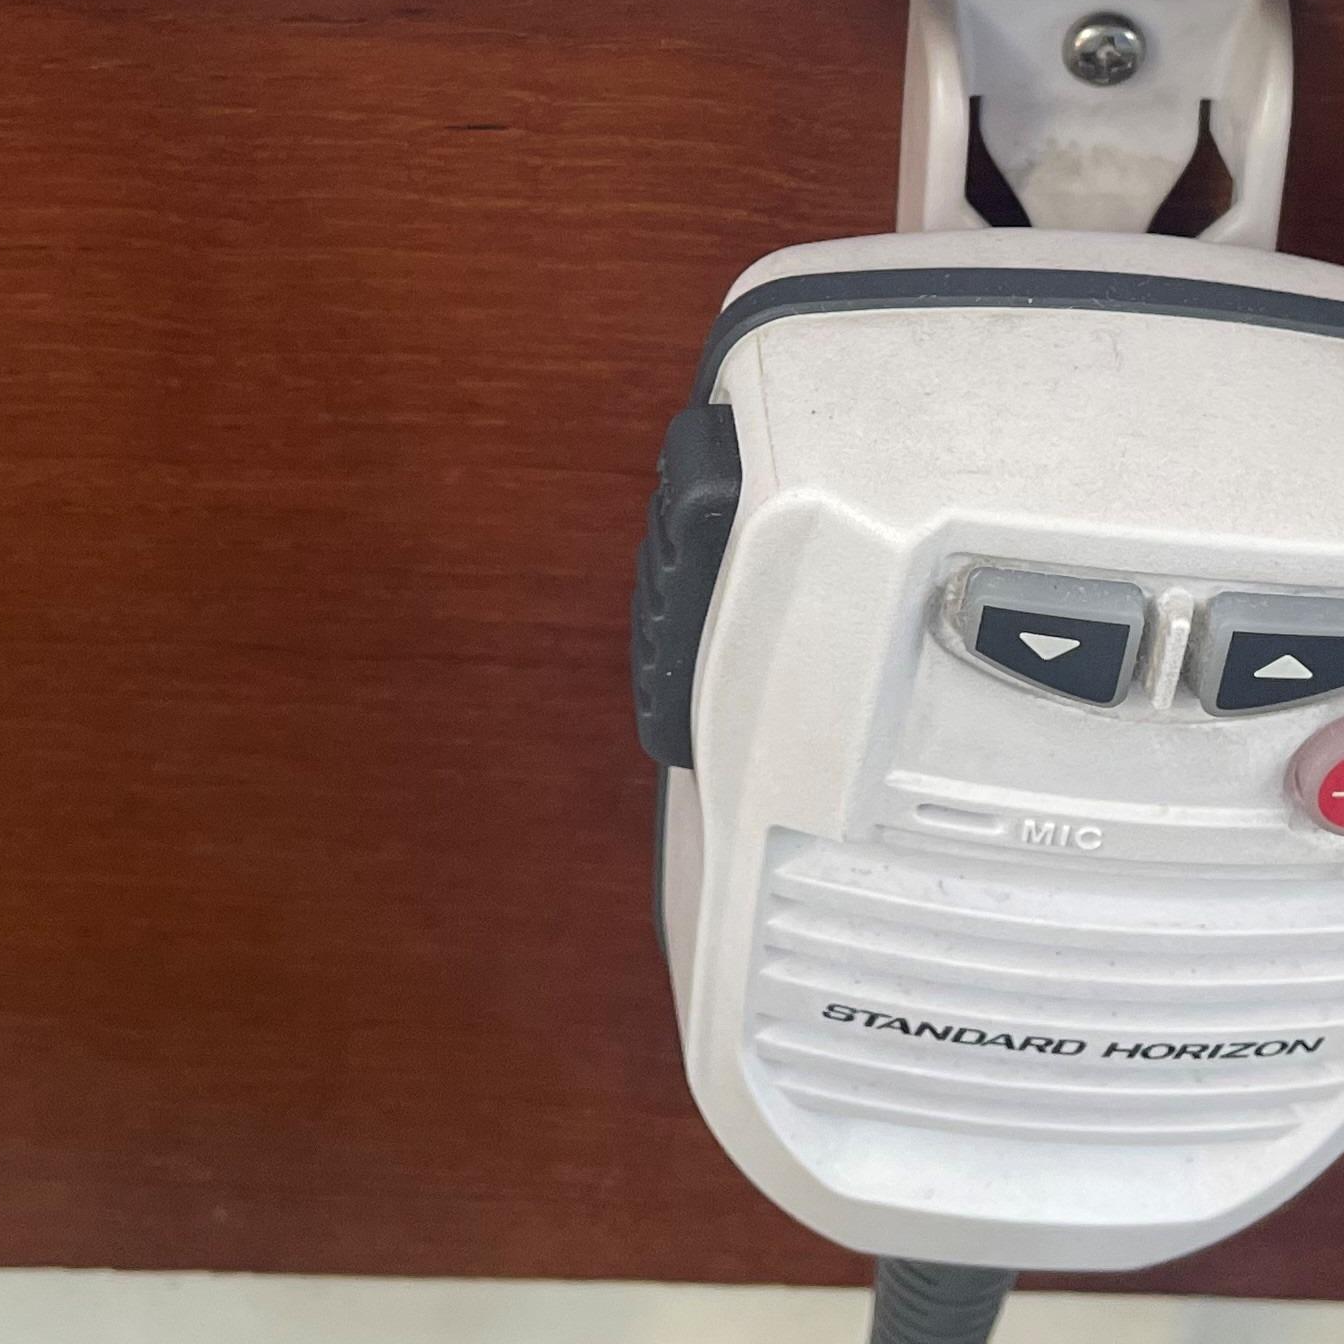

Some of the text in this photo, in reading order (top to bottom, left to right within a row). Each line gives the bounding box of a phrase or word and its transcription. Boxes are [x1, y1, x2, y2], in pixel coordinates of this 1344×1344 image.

[1021, 818, 1104, 851] MIC
[821, 1002, 1325, 1060] STANDARD HORIZON
